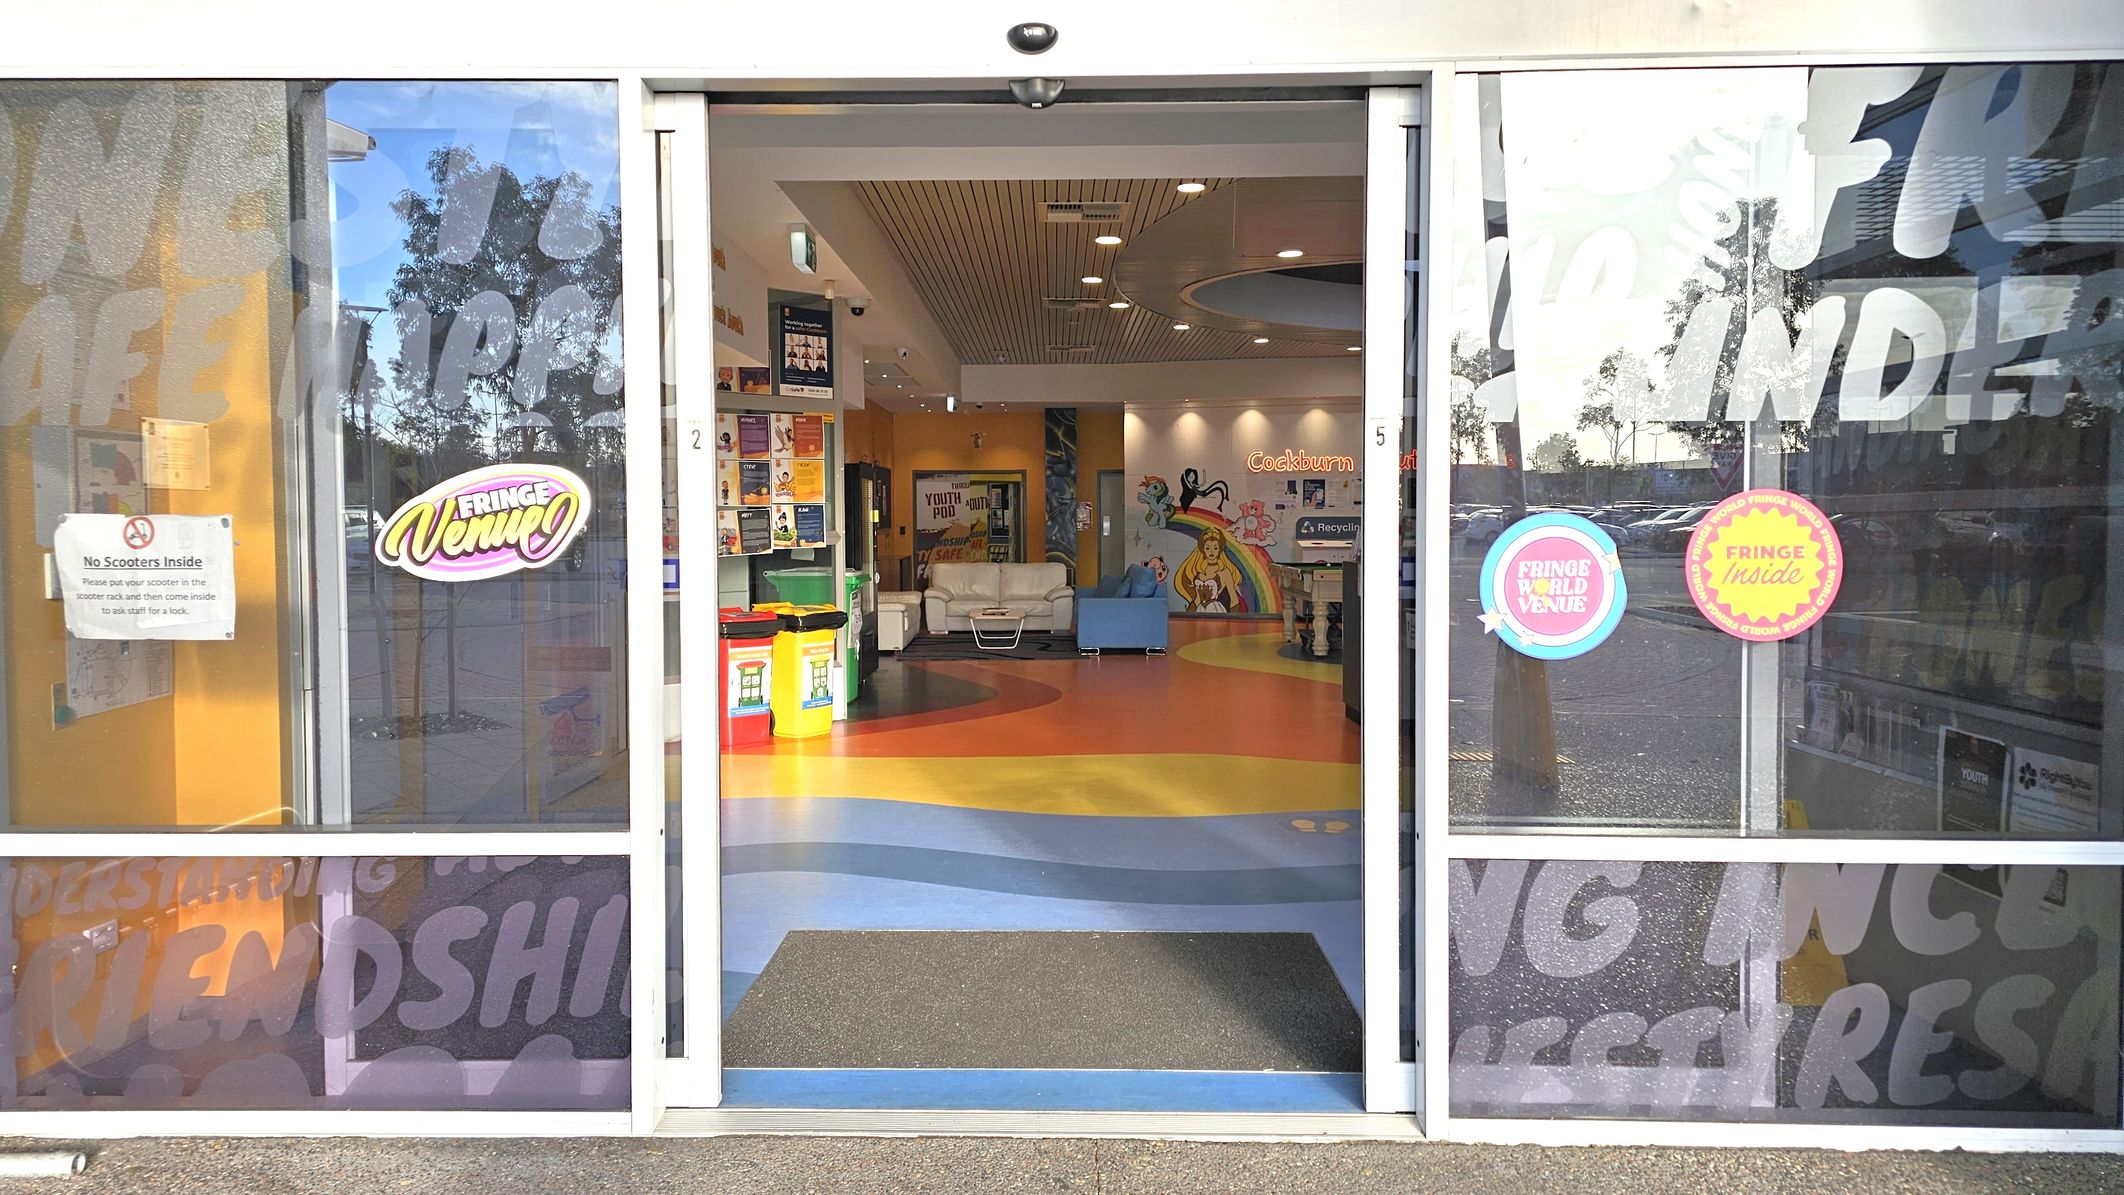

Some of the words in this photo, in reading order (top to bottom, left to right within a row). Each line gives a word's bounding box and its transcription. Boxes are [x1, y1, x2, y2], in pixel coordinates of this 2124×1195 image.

[692, 429, 701, 450] 2
[1377, 426, 1385, 446] 5
[1248, 449, 1354, 472] Cockburn
[456, 480, 551, 519] FRINGE
[925, 492, 961, 506] YOUTH
[1748, 495, 1788, 506] FRINGE
[933, 505, 956, 519] POD
[1710, 499, 1746, 524] WORLD
[1790, 500, 1823, 528] WORLD
[384, 492, 579, 563] Venue
[1692, 524, 1713, 561] FRINGE
[1726, 546, 1805, 559] FRINGE
[1820, 529, 1837, 567] FRINGE
[84, 556, 101, 567] No
[104, 556, 160, 567] Scooters
[164, 556, 203, 567] Inside
[935, 548, 962, 560] SAFE
[1518, 559, 1591, 578] FRINGE
[1722, 560, 1805, 585] Inside
[82, 578, 108, 586] Please
[110, 579, 123, 588] put
[126, 580, 144, 588] your
[181, 578, 189, 586] in
[192, 578, 206, 586] the
[1692, 564, 1708, 601] WORLD
[1816, 569, 1836, 606] WORLD
[144, 592, 162, 600] then
[1517, 596, 1587, 615] VENUE
[1706, 601, 1739, 630] FRINGE
[1783, 606, 1818, 631] FRINGE
[1741, 625, 1780, 636] WORLD
[1961, 767, 1988, 786] YOUTH
